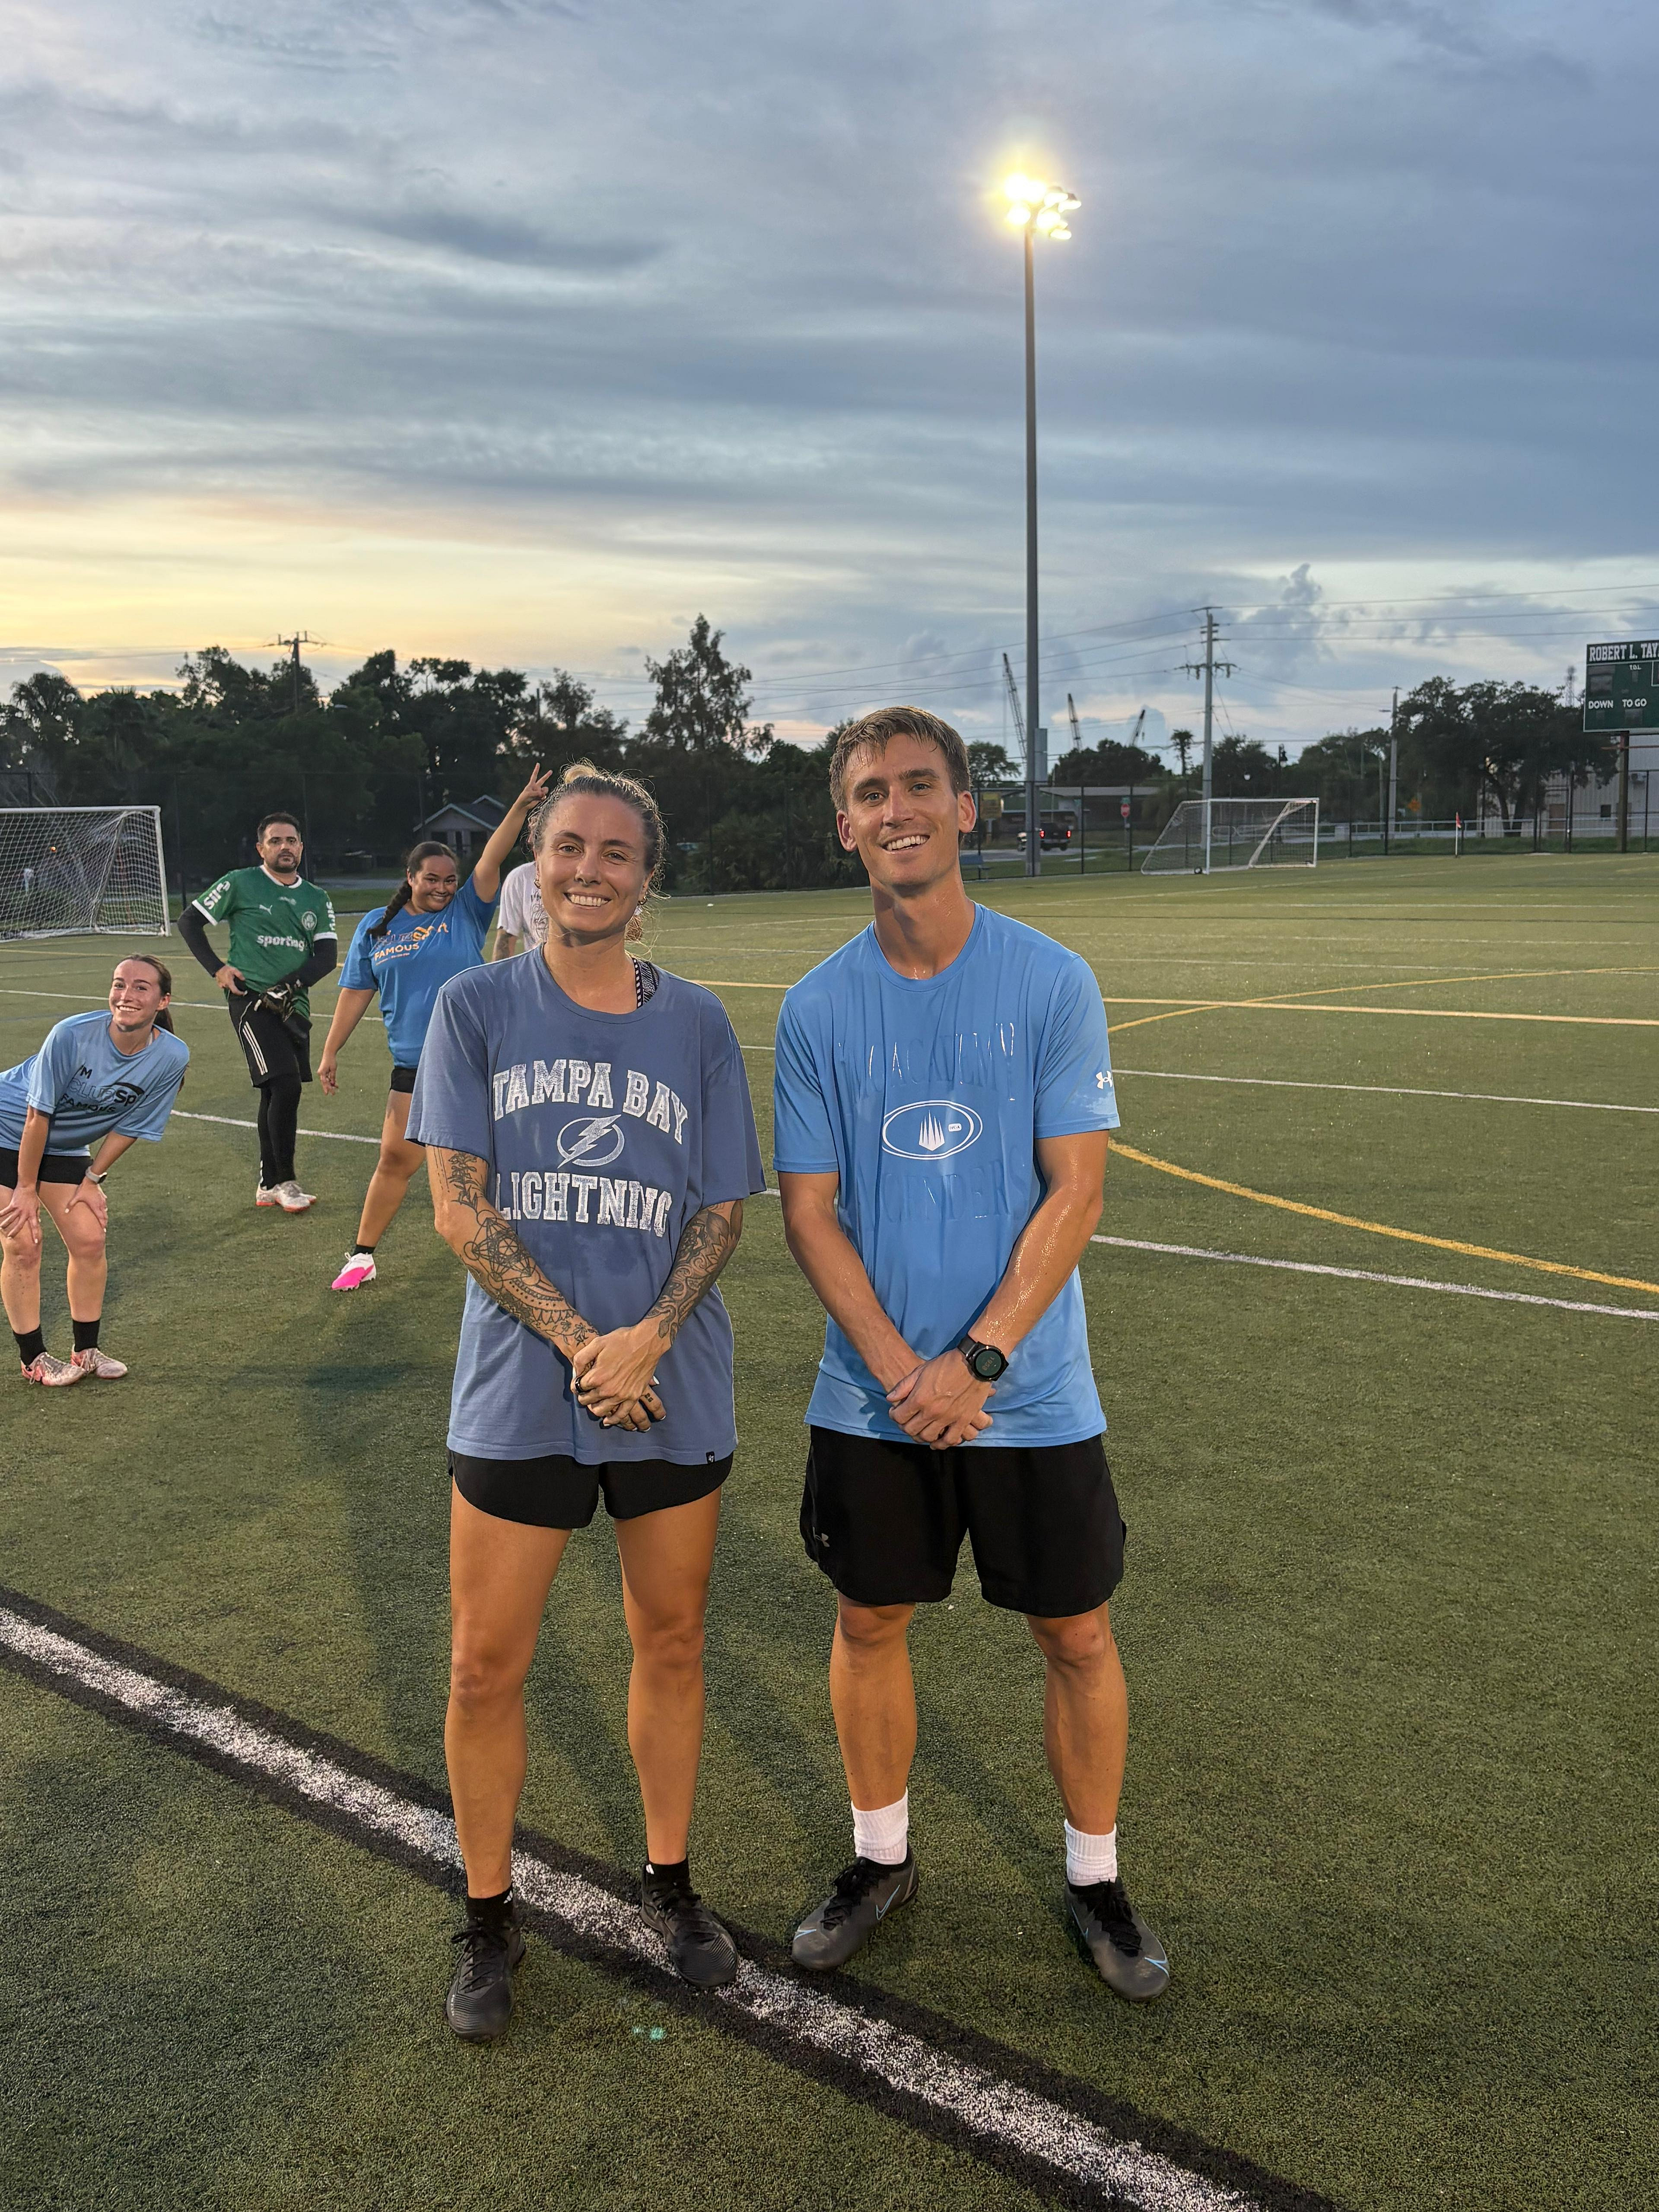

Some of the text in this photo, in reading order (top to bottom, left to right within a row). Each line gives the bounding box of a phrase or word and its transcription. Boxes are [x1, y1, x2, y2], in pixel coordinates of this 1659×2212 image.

[1589, 642, 1659, 662] ROBERT L. TAY
[1588, 700, 1614, 709] DOWN
[1622, 698, 1647, 708] TO GO
[374, 942, 420, 961] FAMOUS
[493, 1059, 688, 1144] TAMPA BAY
